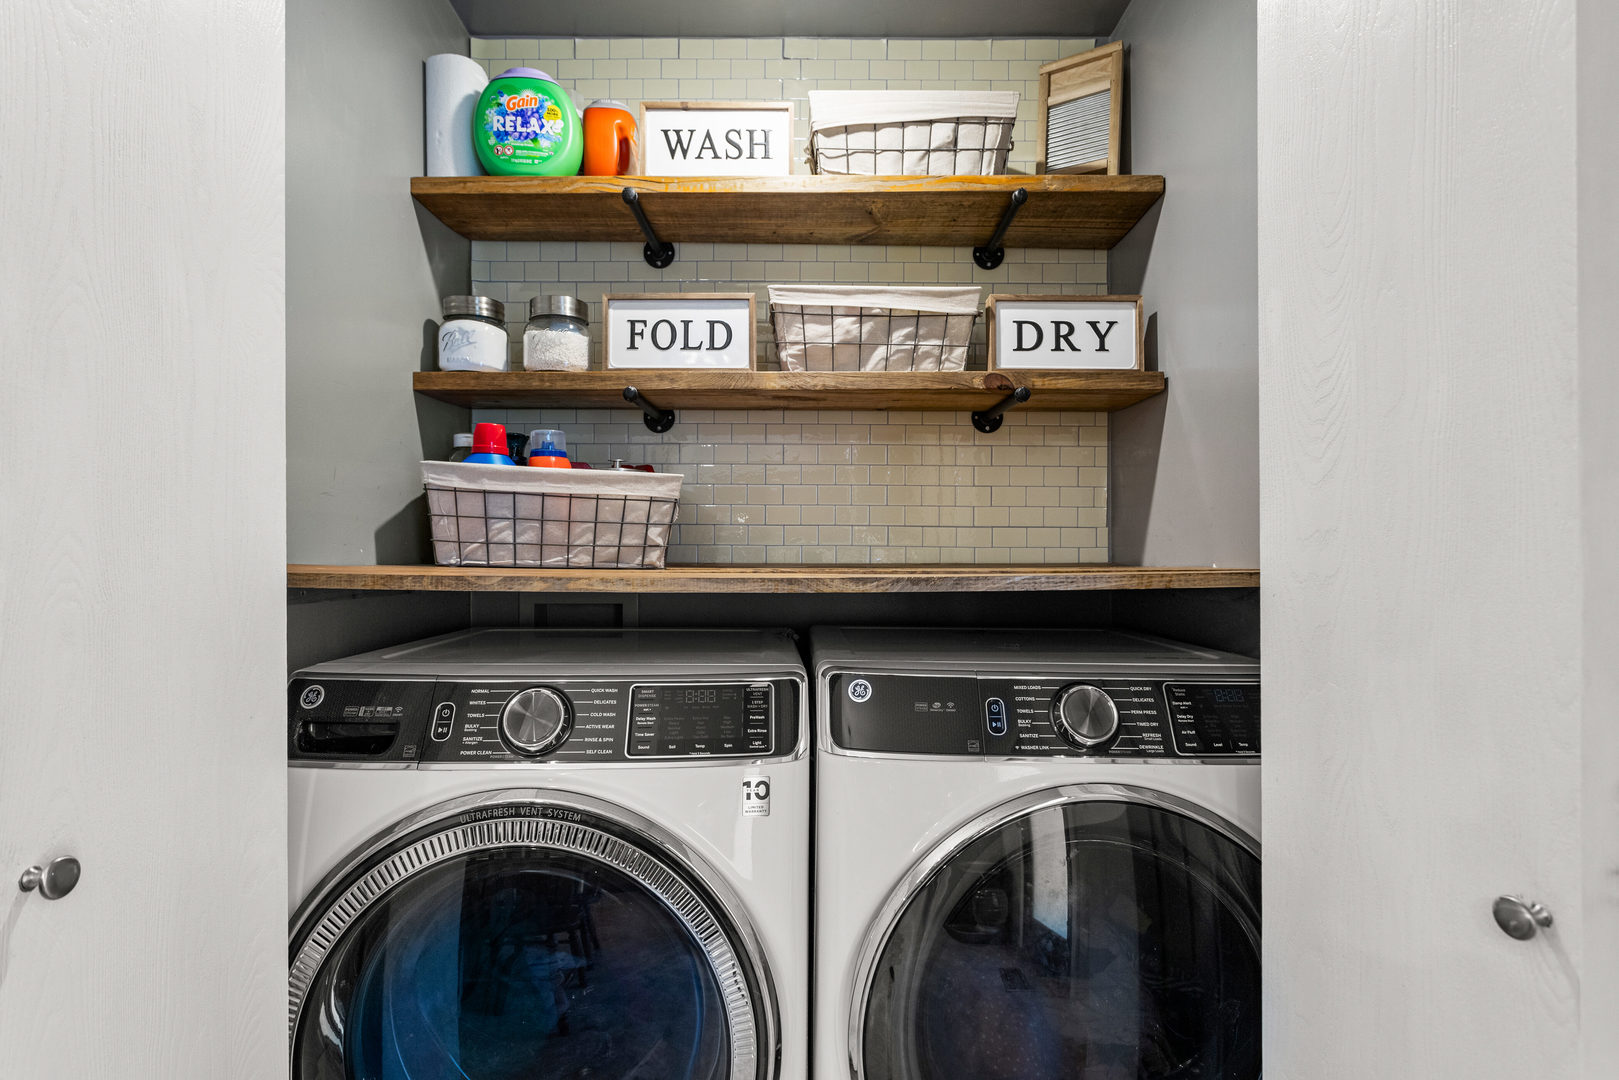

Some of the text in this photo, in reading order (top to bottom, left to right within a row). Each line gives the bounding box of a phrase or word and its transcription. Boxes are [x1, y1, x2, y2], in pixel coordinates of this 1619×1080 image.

[506, 94, 538, 112] Gain
[492, 116, 554, 135] RELAX
[660, 128, 774, 160] WASH
[626, 318, 733, 351] FOLD
[1012, 320, 1118, 352] DRY
[742, 780, 770, 800] 10
[460, 807, 581, 824] ULTRAFRESH VENT SYSTEM
